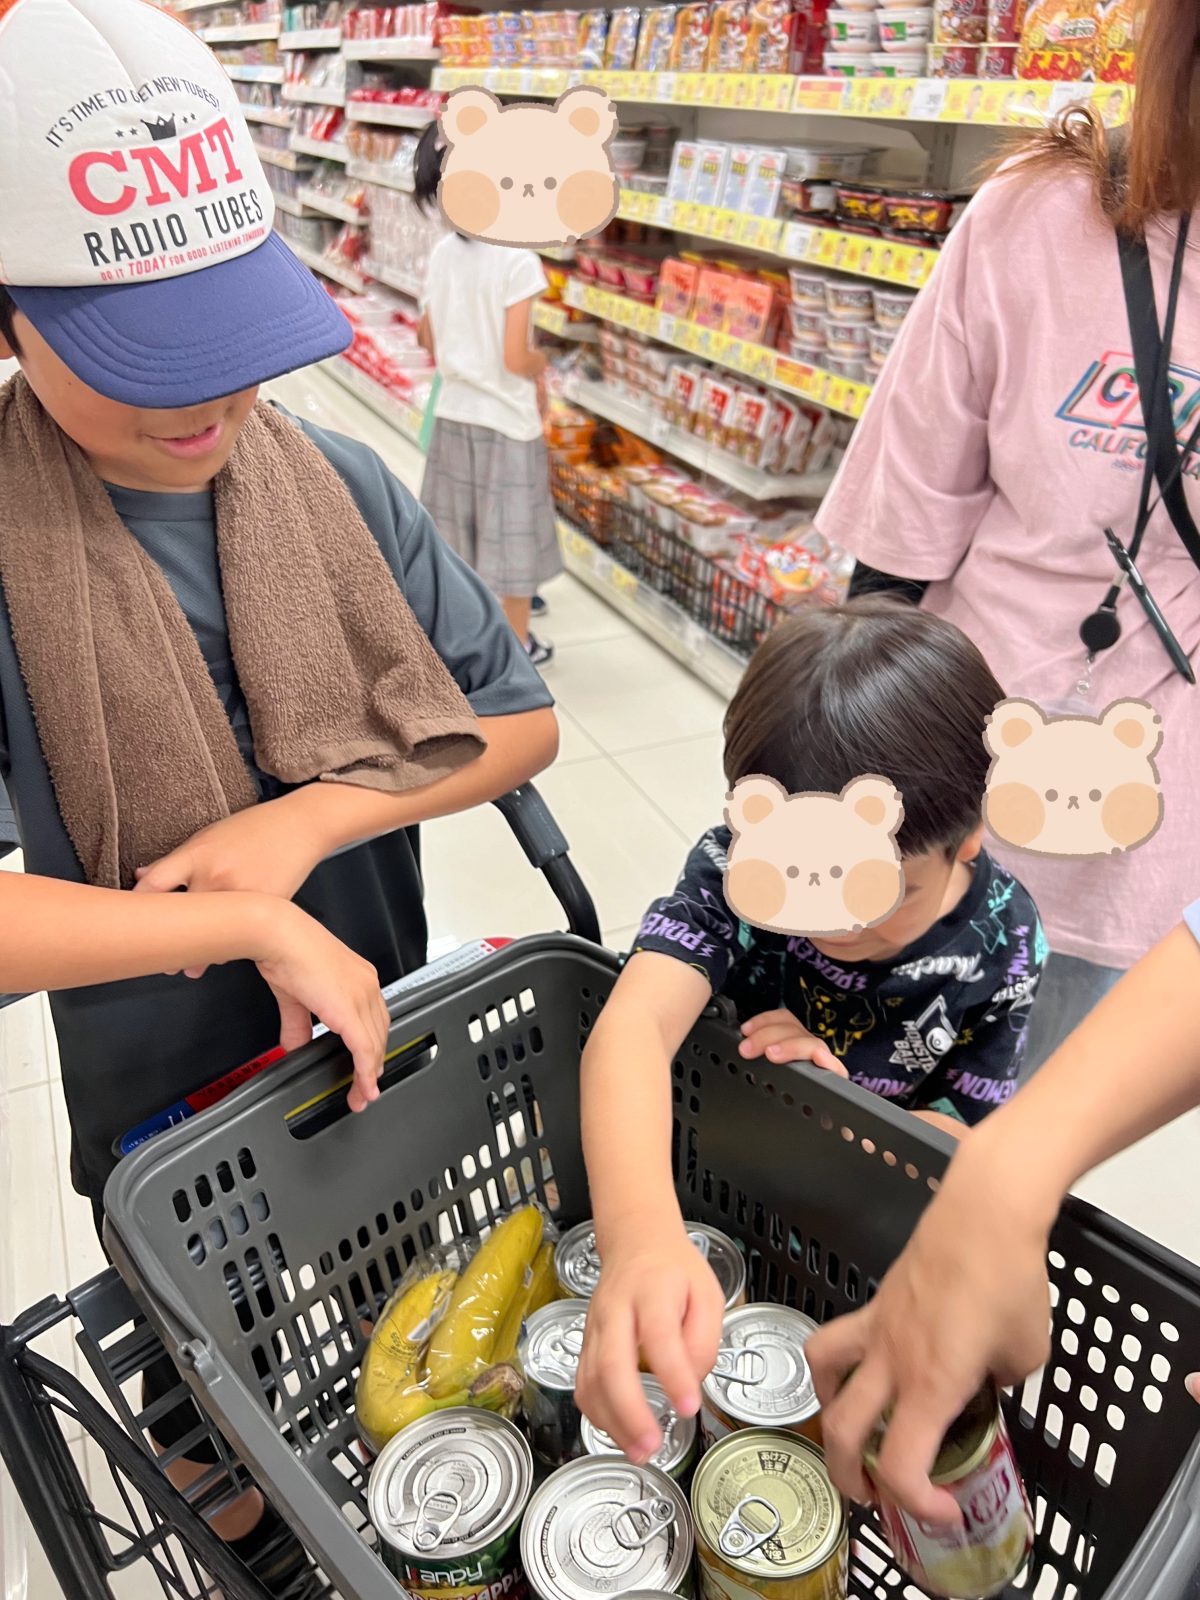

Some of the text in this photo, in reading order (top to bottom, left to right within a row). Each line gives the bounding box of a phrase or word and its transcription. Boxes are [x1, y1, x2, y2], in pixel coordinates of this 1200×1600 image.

[45, 76, 221, 148] IT'S TIME TO GET NEW TUBES!
[68, 117, 243, 216] CMT
[83, 188, 263, 267] RADIO TUBES
[101, 271, 113, 281] DO
[116, 268, 125, 278] IT
[129, 255, 167, 276] TODAY
[170, 253, 186, 267] FOR
[188, 247, 208, 261] GOOD
[210, 236, 241, 255] LISTENING
[894, 1040, 921, 1073] BALL
